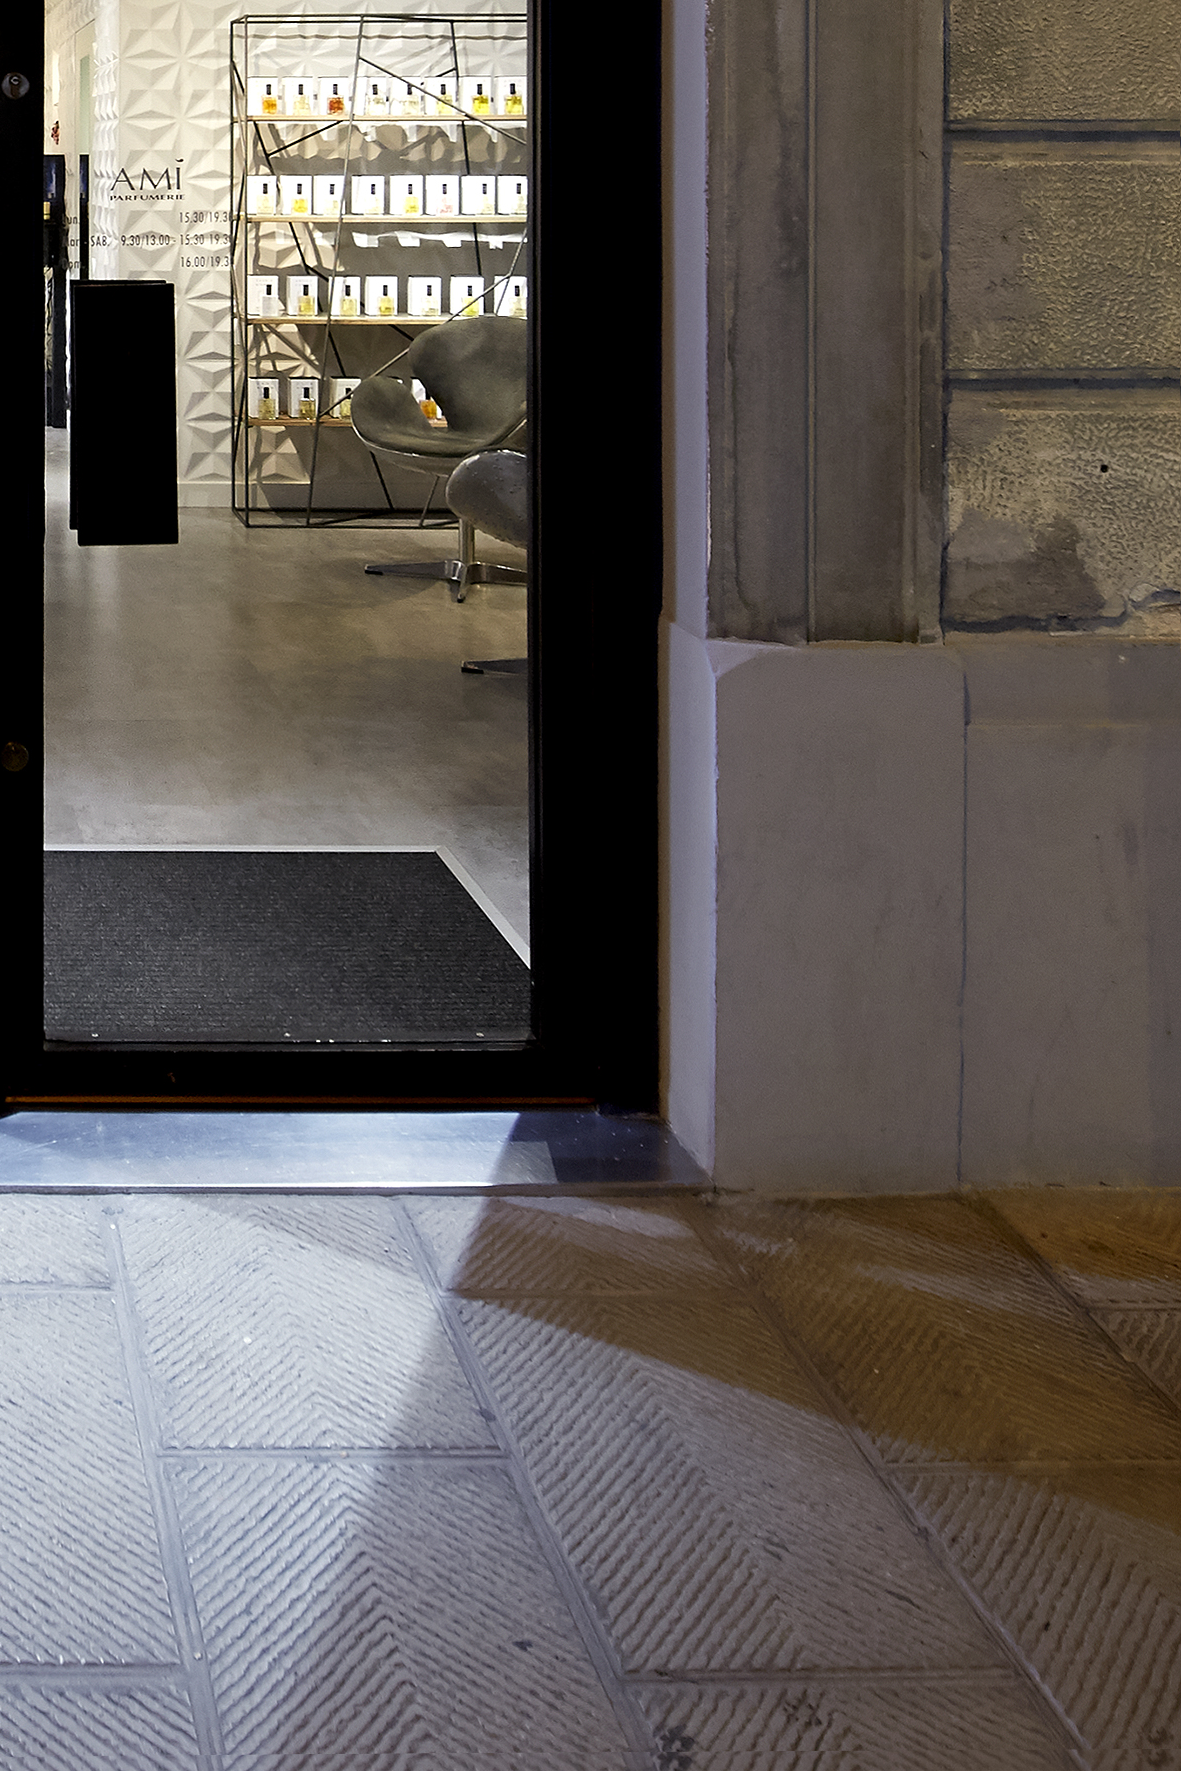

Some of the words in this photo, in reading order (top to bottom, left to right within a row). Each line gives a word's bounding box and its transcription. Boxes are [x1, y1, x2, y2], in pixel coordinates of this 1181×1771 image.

[109, 194, 186, 202] PARFUMERIE
[120, 234, 170, 247] 9.30/13.00
[180, 256, 234, 268] 16.00/19.3
